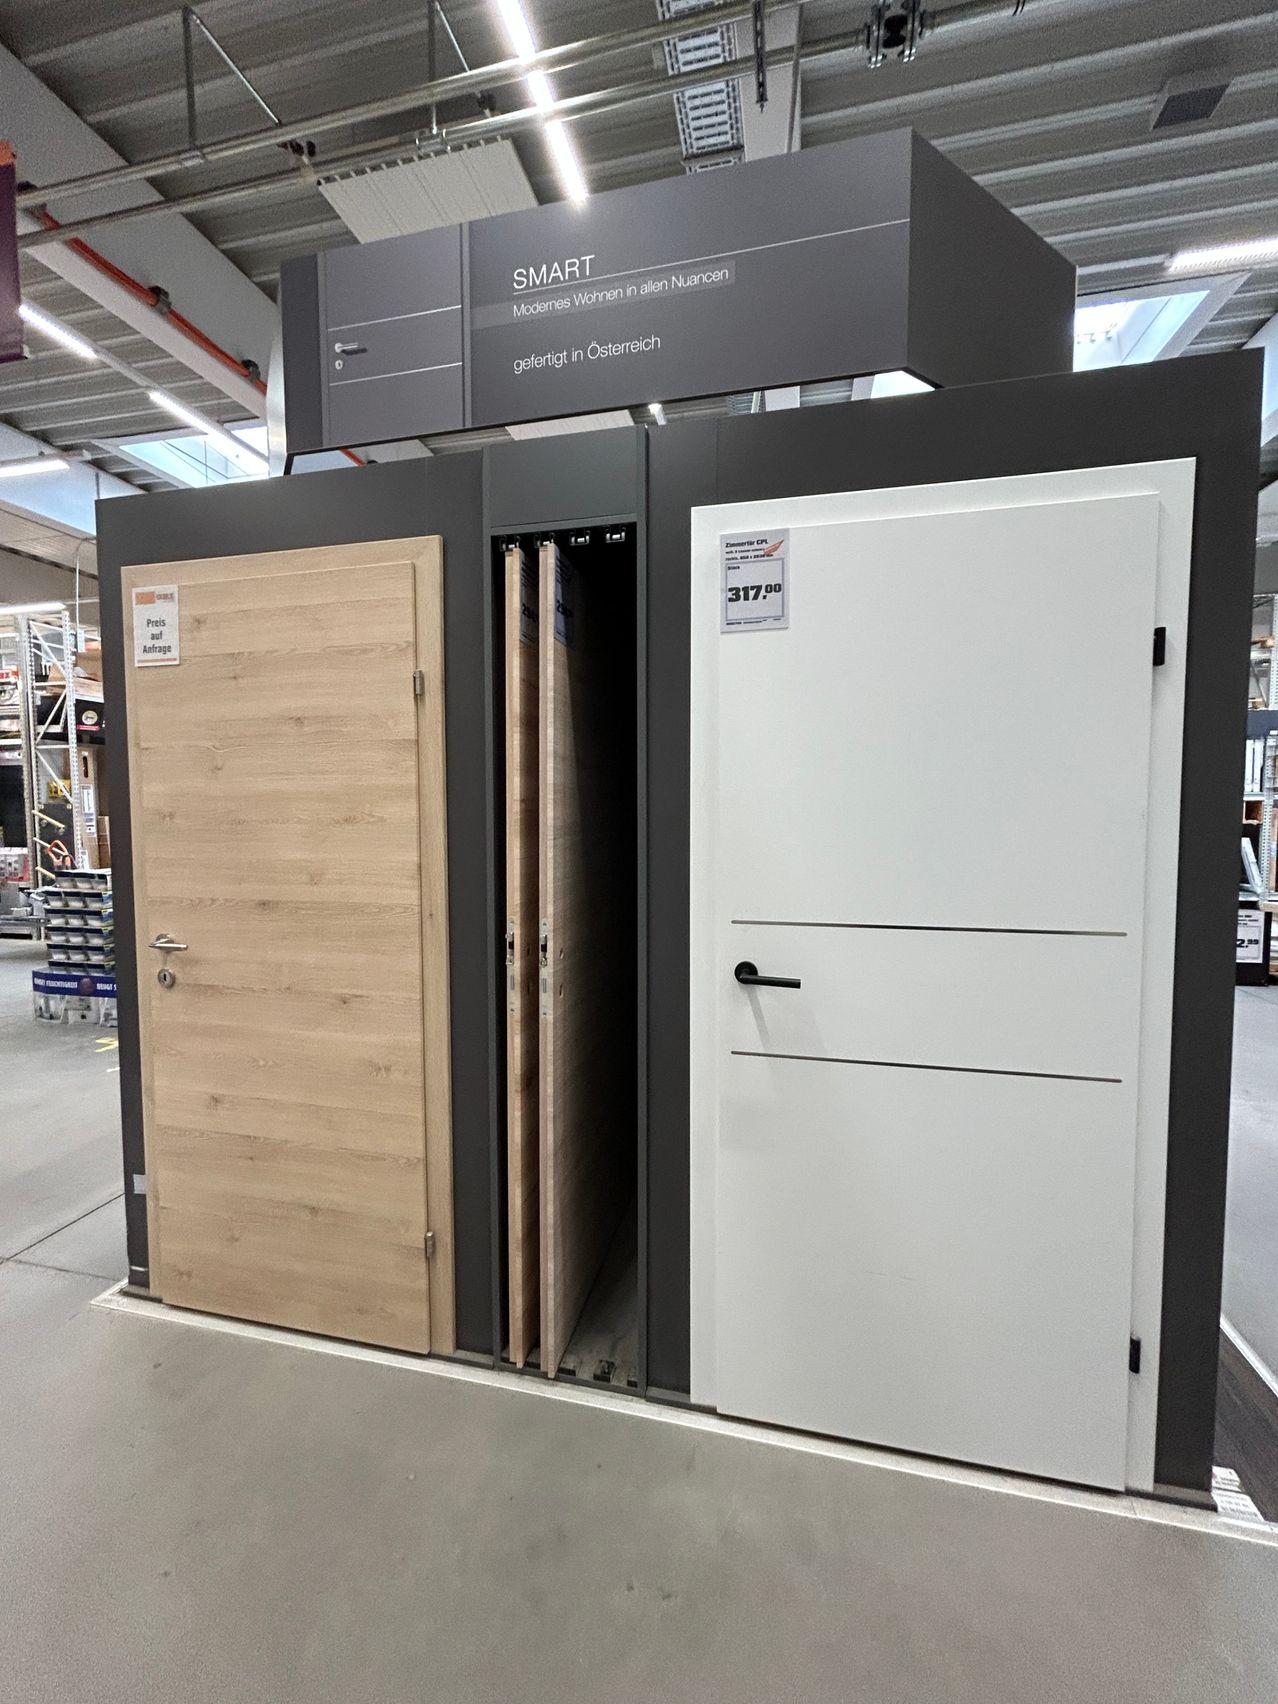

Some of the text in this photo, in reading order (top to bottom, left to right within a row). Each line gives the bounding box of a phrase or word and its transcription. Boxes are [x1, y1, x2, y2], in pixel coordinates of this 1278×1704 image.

[513, 254, 596, 290] SMART
[513, 268, 729, 318] Modernes Wohnen in allen Nuancen
[513, 334, 661, 375] gefertigt in Österreich
[725, 540, 756, 548] Zimmertür
[728, 583, 782, 603] 317.00
[146, 618, 166, 628] Preis
[150, 630, 163, 640] auf
[142, 644, 172, 655] Anfrage
